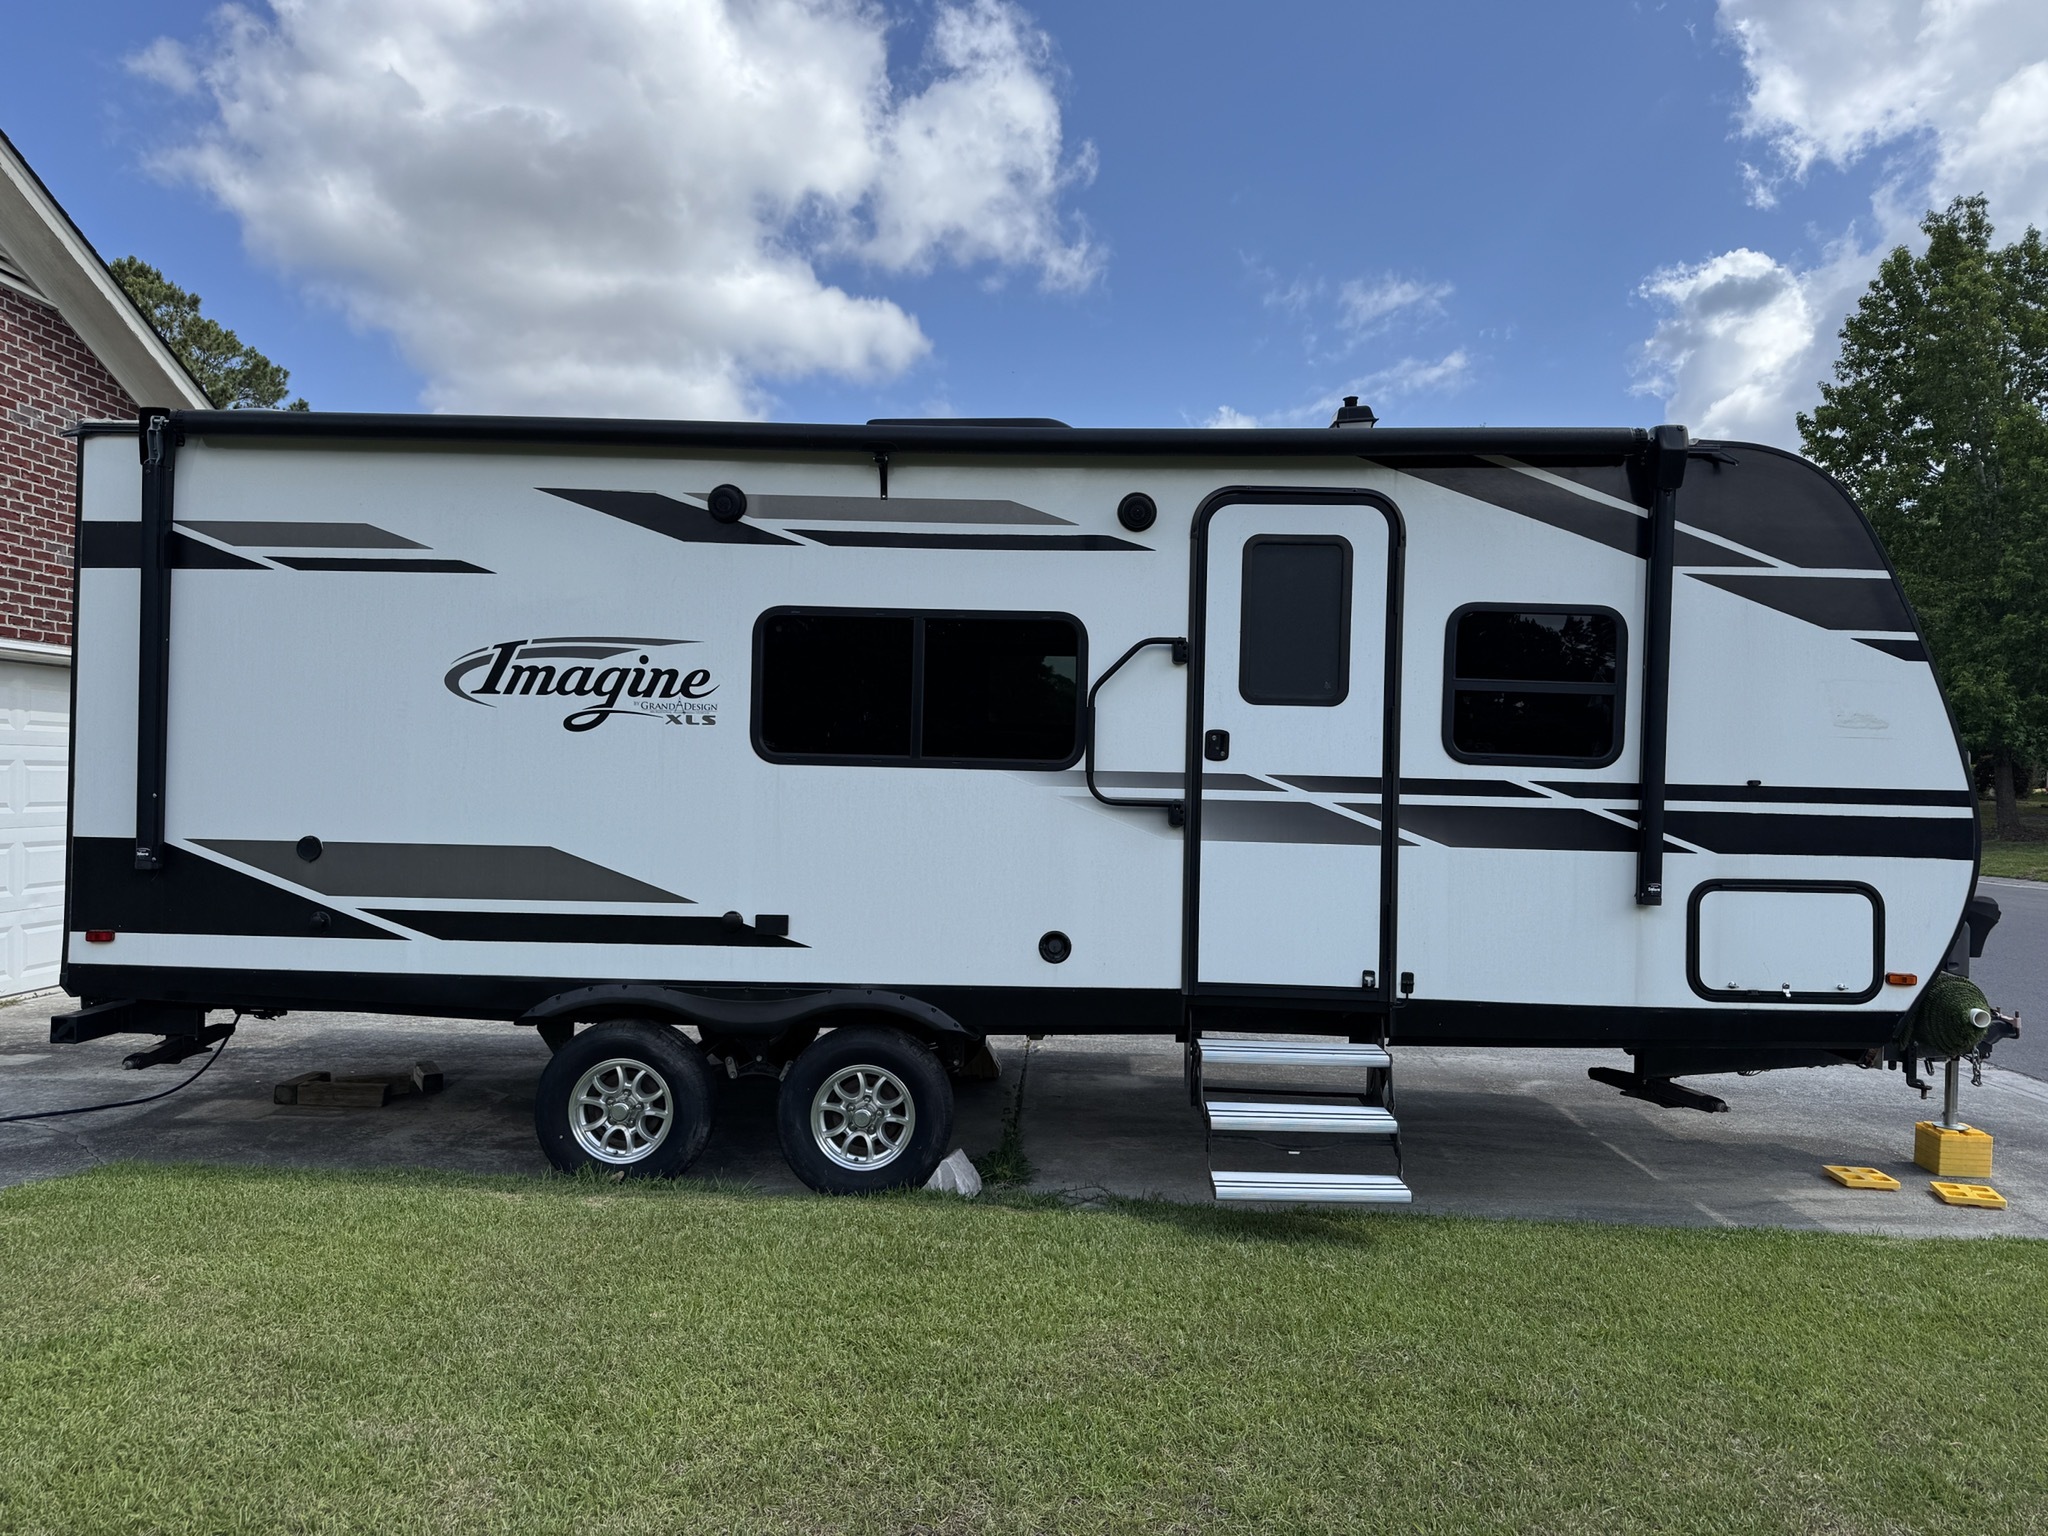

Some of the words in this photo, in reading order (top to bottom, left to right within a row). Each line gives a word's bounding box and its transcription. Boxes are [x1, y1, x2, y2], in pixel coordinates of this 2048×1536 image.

[470, 639, 720, 732] Imagine
[640, 701, 676, 710] GRAND
[684, 702, 718, 711] DESIGN
[665, 714, 716, 726] XLS
